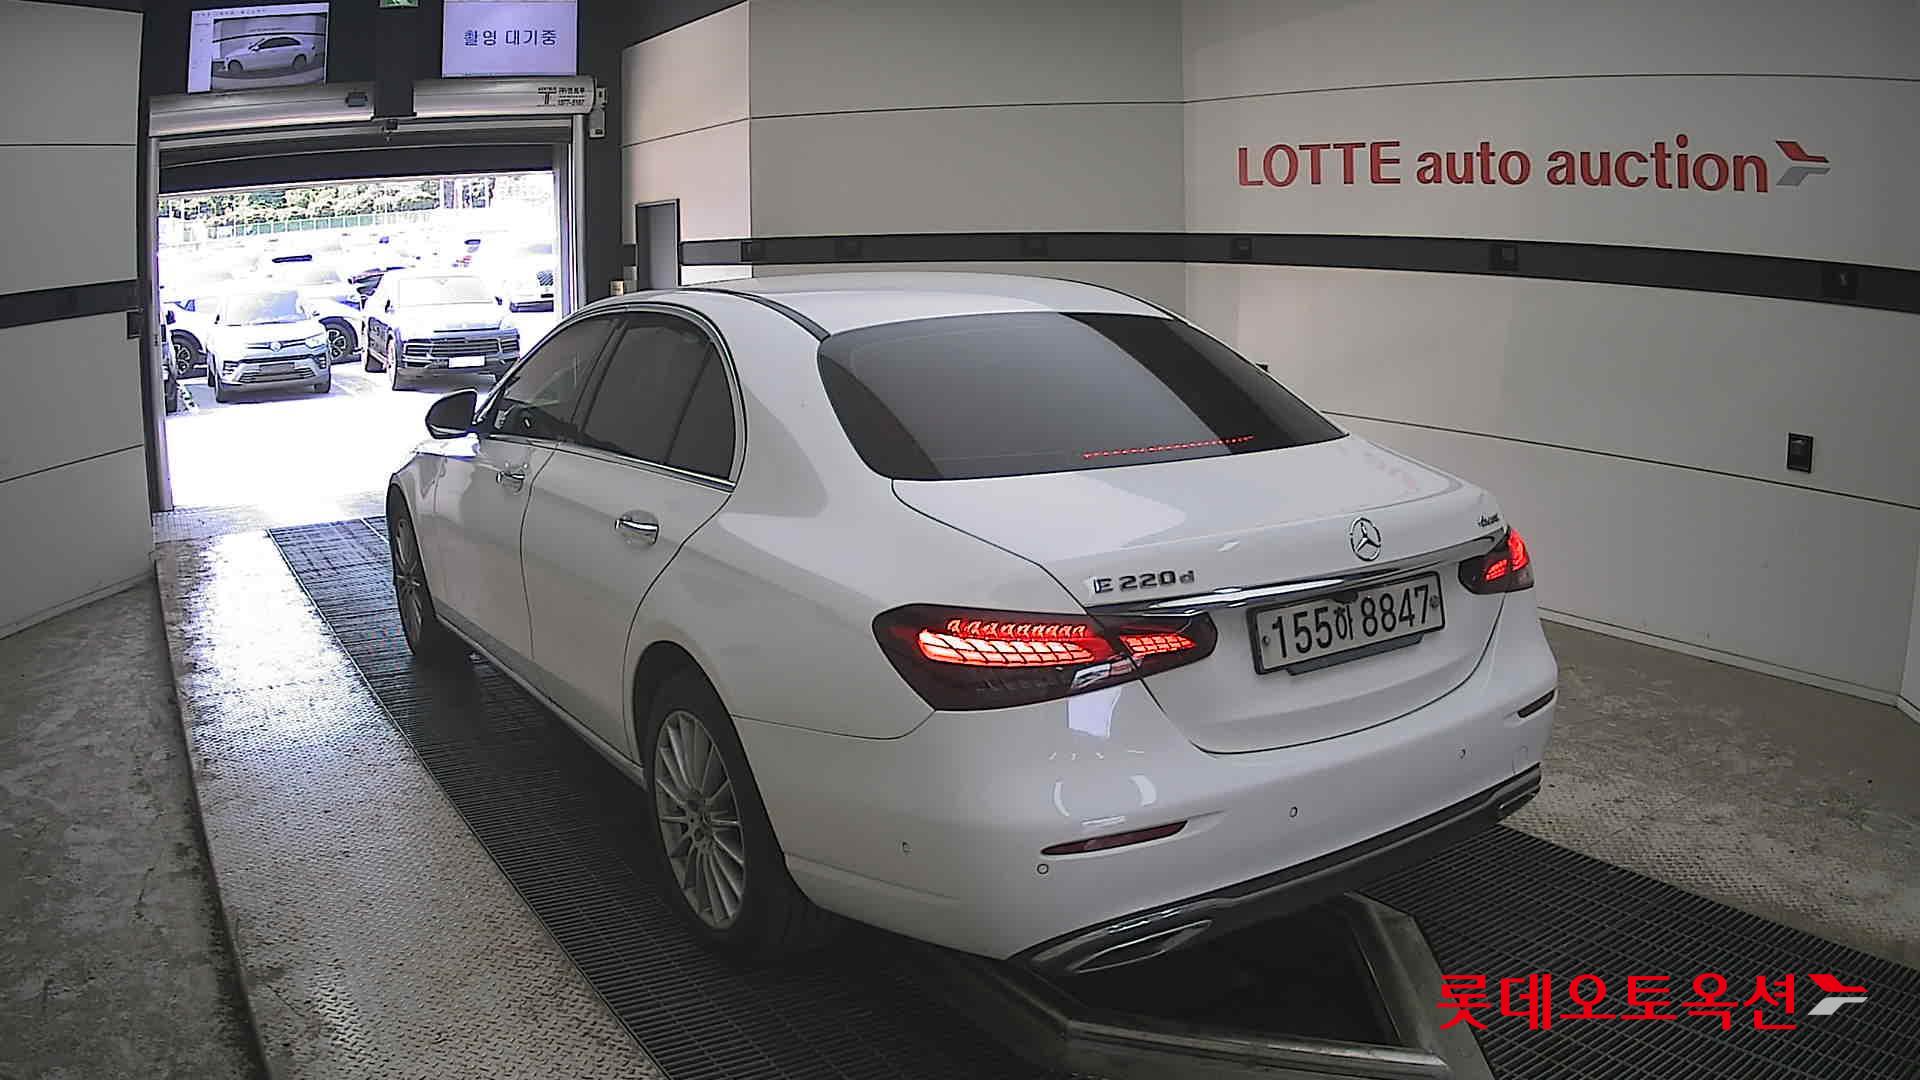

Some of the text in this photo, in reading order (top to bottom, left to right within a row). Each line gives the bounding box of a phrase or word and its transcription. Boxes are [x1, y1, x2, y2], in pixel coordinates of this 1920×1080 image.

[505, 29, 557, 46] 대기중
[1238, 133, 1768, 193] LOTTE auto auction
